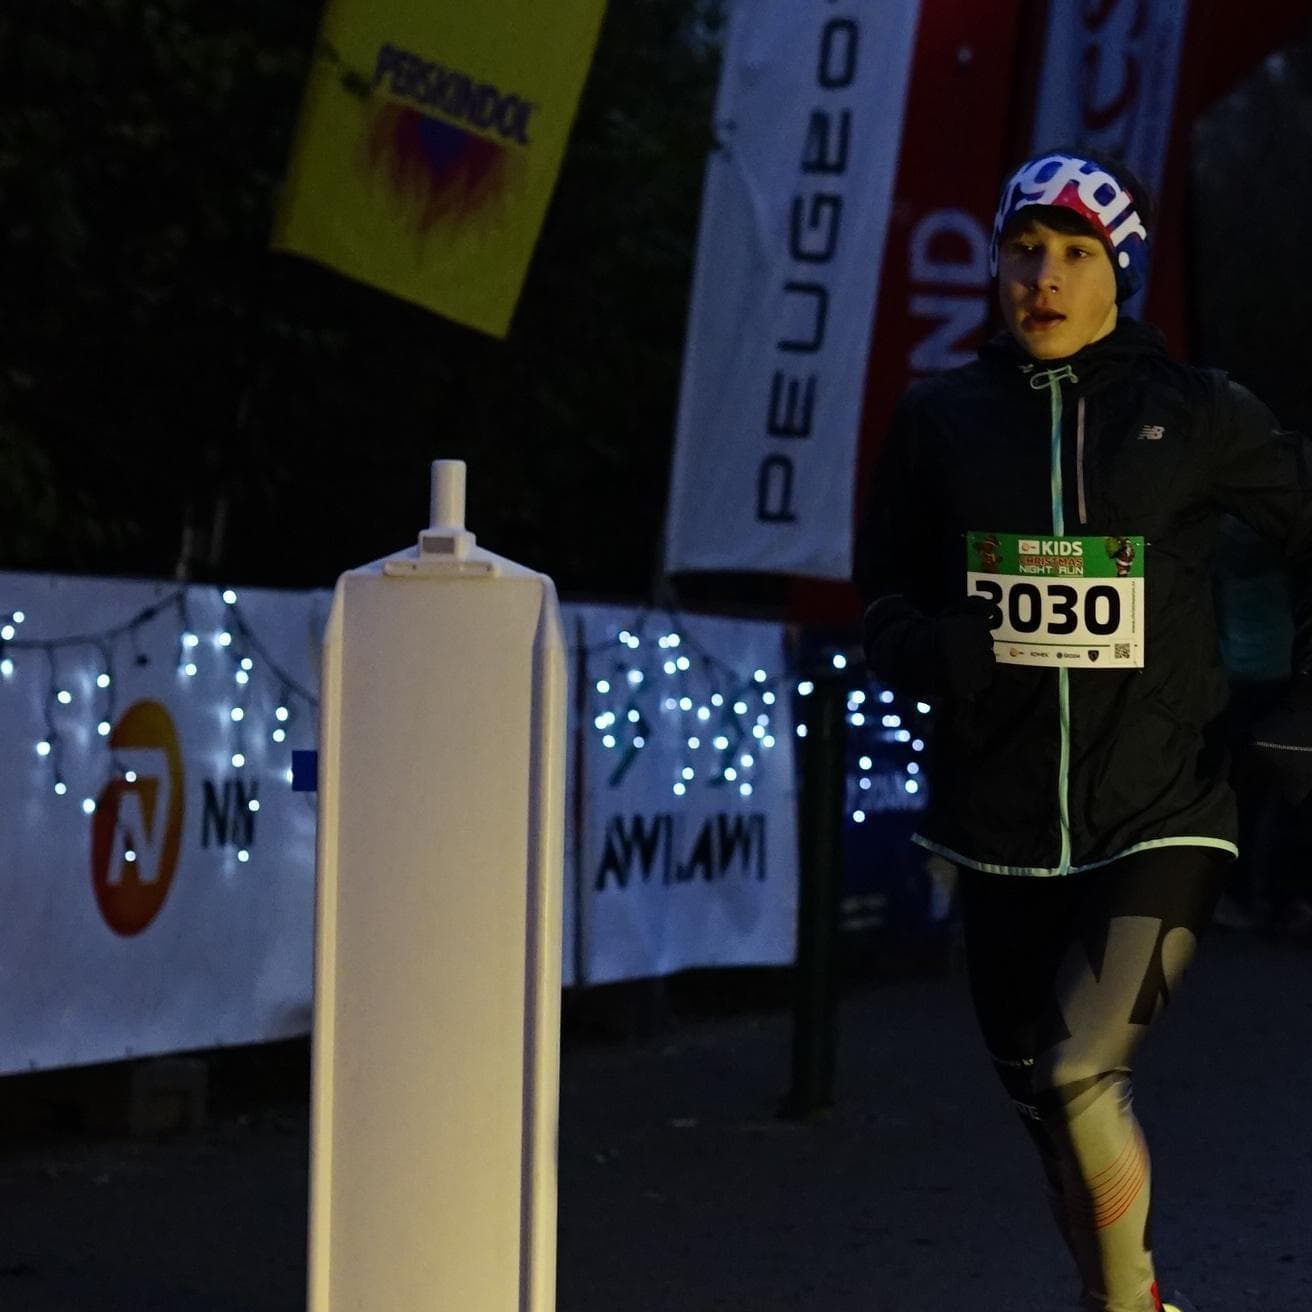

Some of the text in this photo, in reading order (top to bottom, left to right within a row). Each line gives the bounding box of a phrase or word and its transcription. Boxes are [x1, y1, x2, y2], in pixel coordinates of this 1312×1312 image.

[1042, 540, 1083, 556] KIDS
[1019, 556, 1083, 566] CHRISTMAS
[1019, 565, 1084, 575] NIGHT RUN
[976, 581, 1121, 635] 3030
